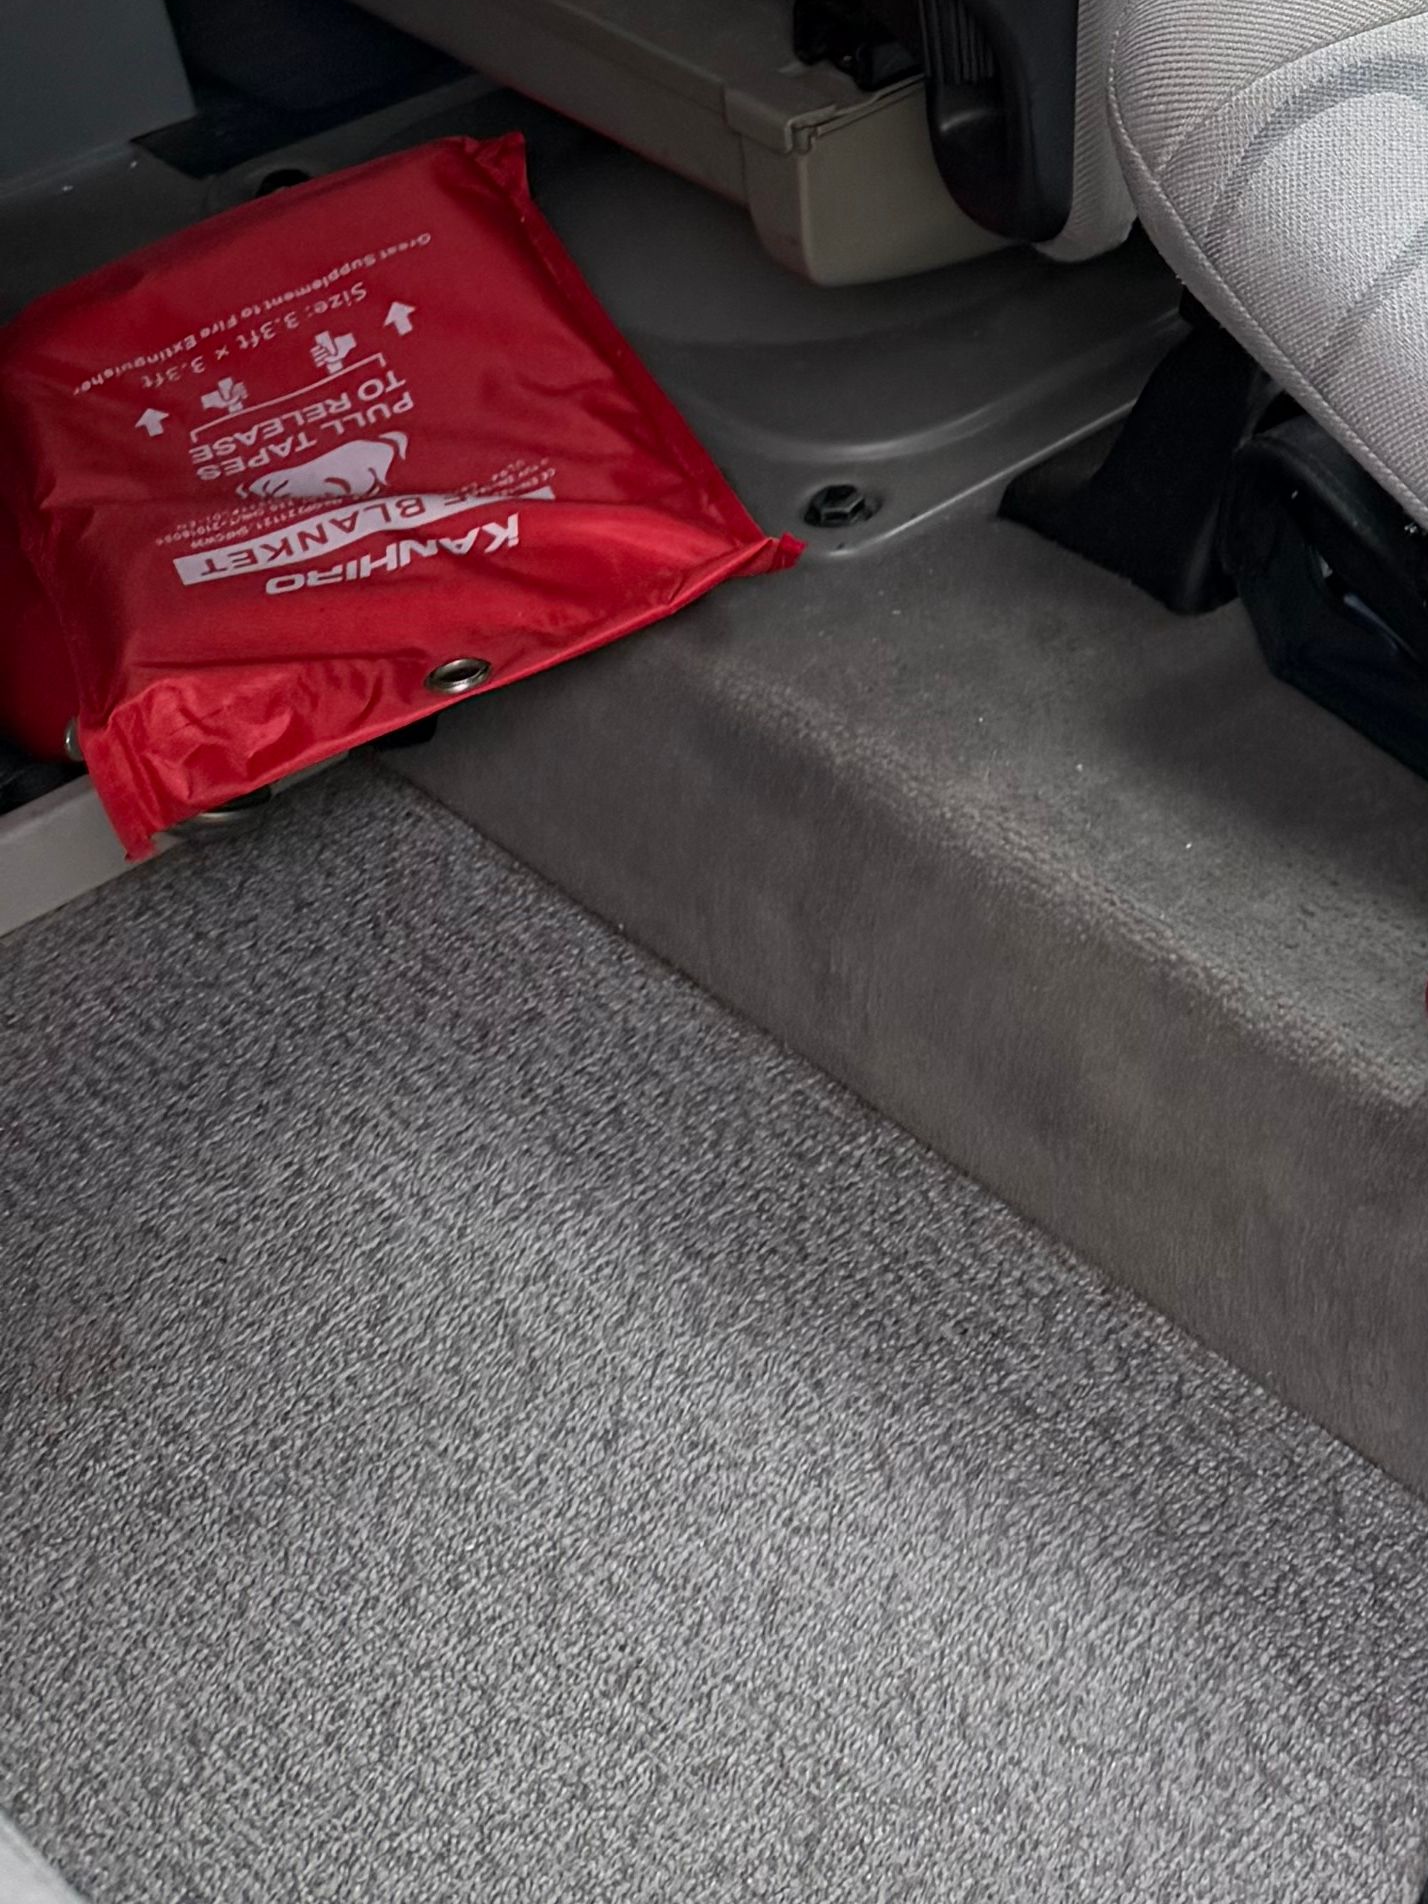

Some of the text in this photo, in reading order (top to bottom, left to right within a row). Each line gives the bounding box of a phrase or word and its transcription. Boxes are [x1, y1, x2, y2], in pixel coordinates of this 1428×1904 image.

[72, 232, 432, 396] Great Supplement to Fire Extinguisher
[236, 310, 301, 350] 3.3ft
[305, 281, 367, 317] Size:
[141, 354, 207, 390] 3.3ft
[188, 370, 406, 464] TO RELEASE
[196, 391, 414, 480] PULL TAPES
[199, 496, 426, 576] BLANKET
[265, 512, 521, 596] KANHIRO
